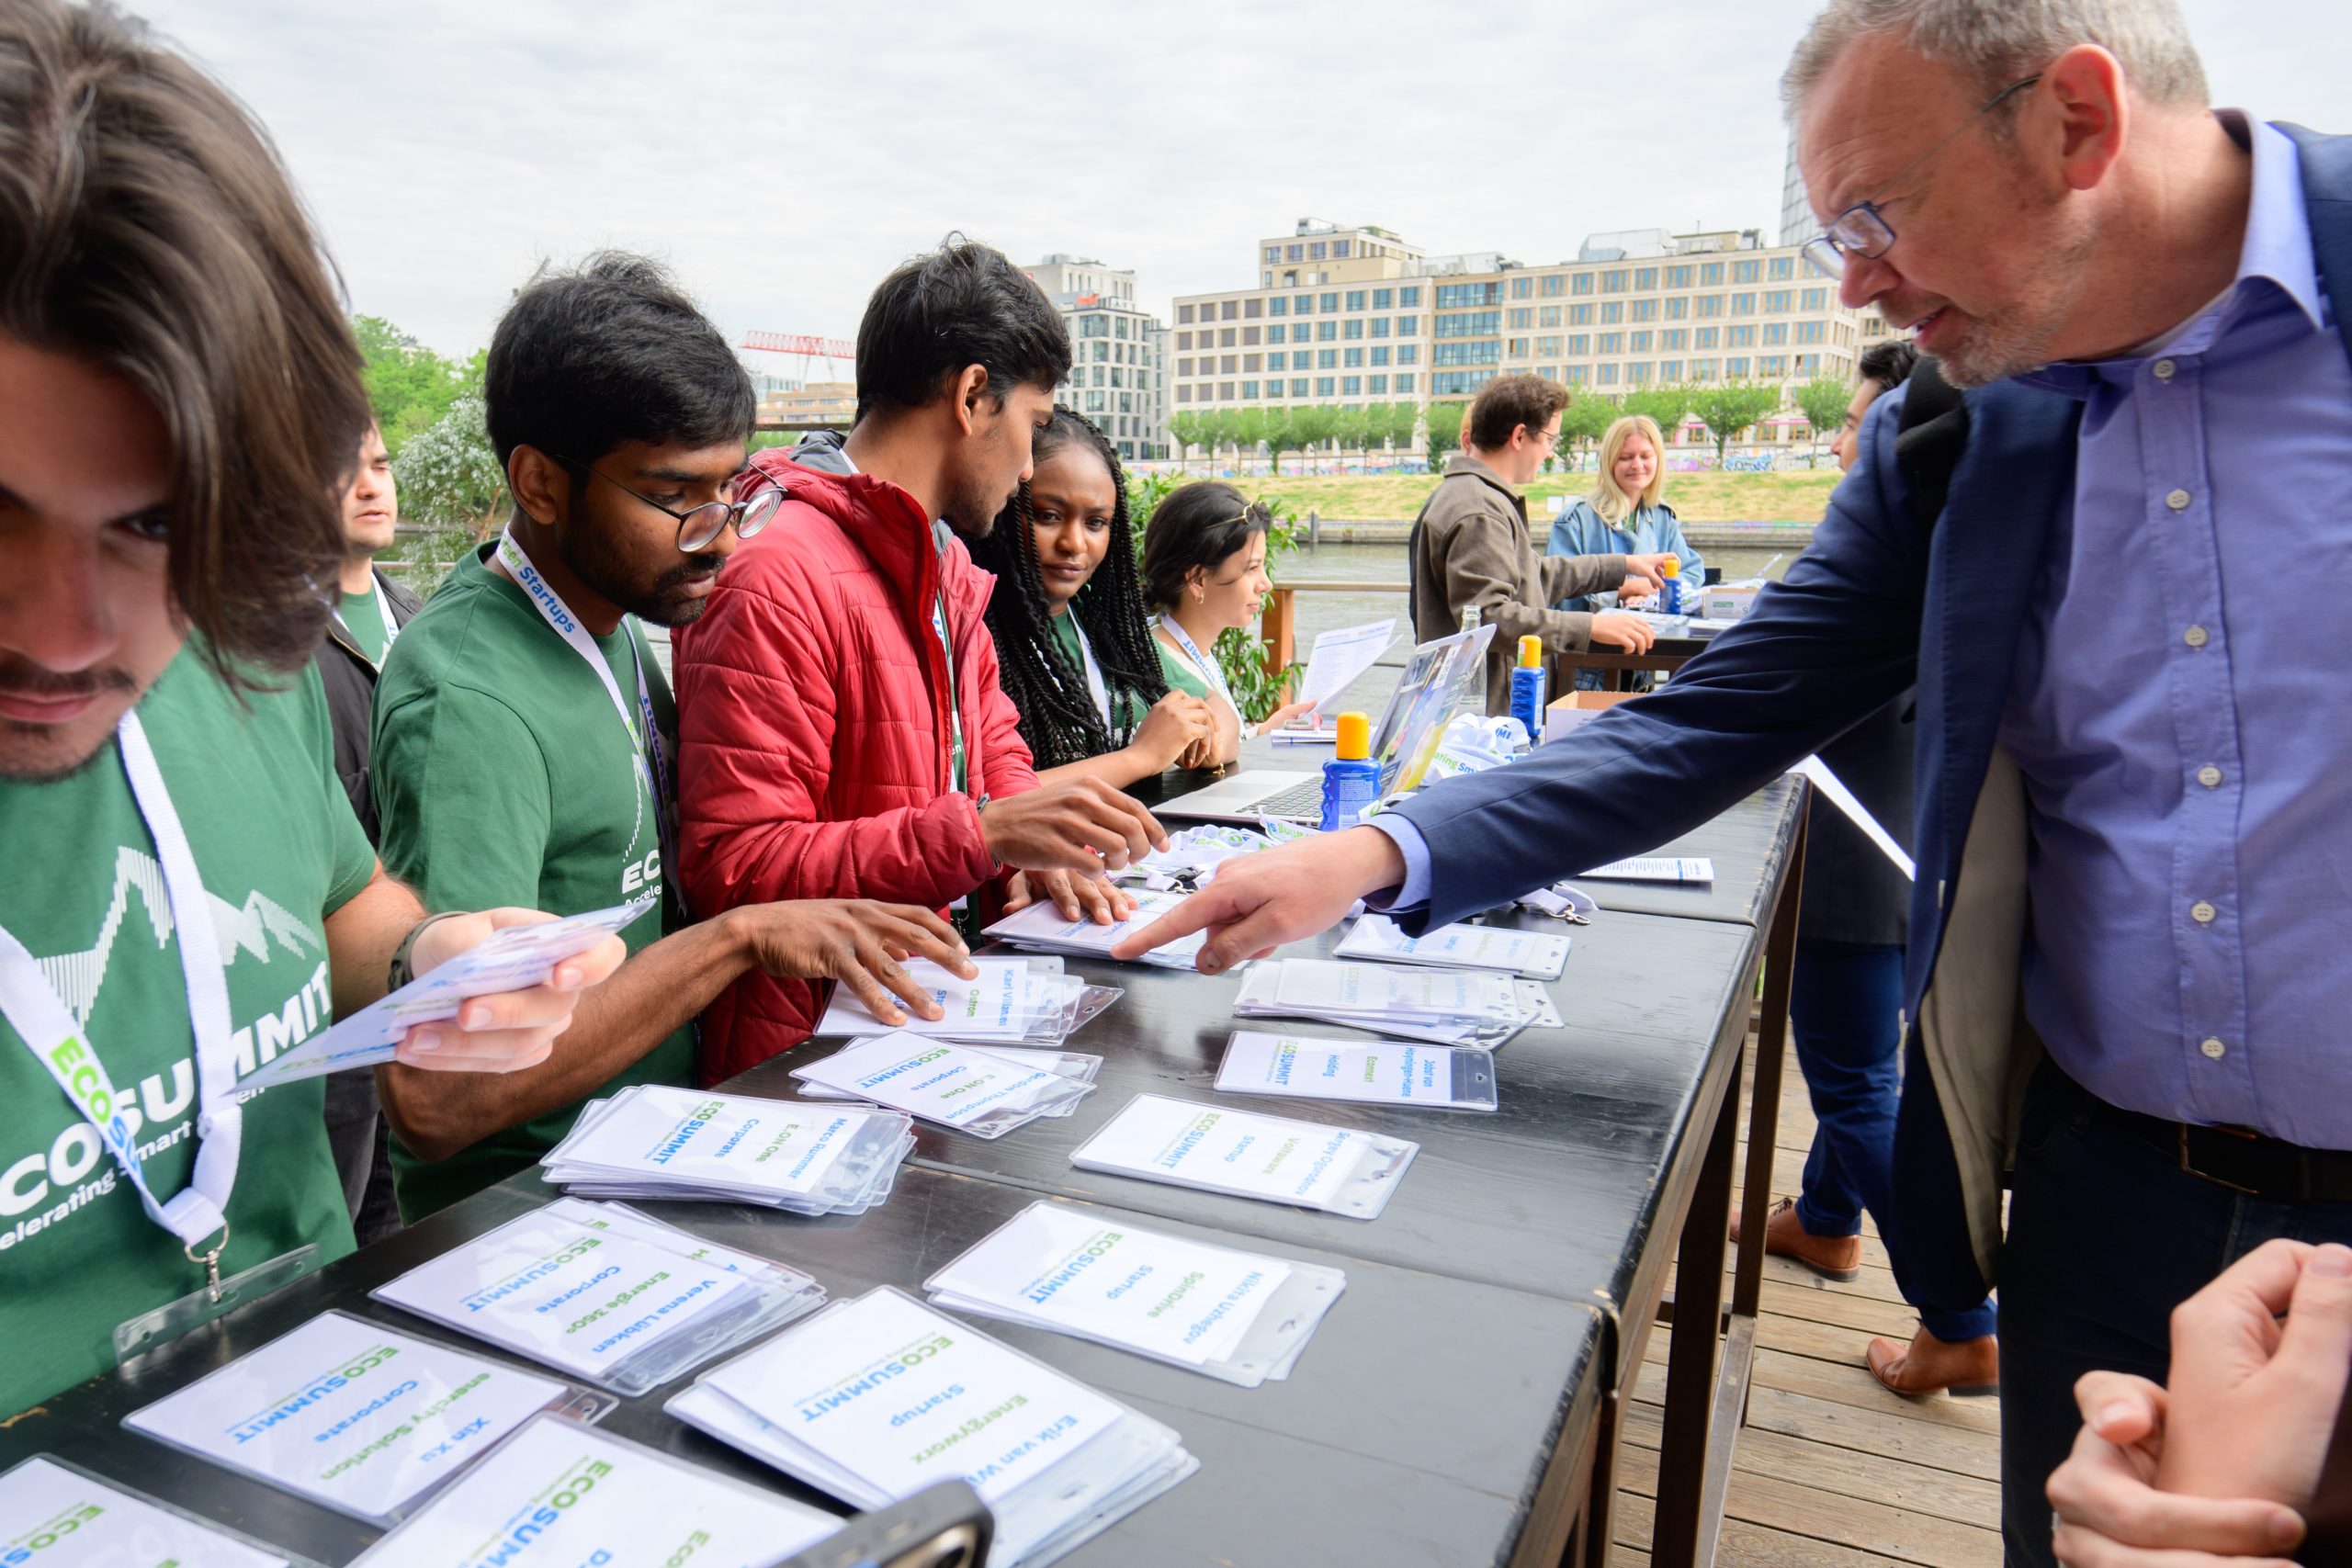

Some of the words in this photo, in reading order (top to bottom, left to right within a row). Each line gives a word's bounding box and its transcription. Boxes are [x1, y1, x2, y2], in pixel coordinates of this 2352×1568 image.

[501, 540, 524, 570] reen
[519, 567, 576, 633] Startups
[967, 989, 978, 1017] Ostrom
[999, 992, 1012, 1026] Villanen
[861, 1048, 950, 1089] ECOSUMMIT
[910, 1066, 967, 1090] Corporate
[1275, 1040, 1298, 1085] ECOSUMMIT
[1323, 1055, 1339, 1077] Holding
[1364, 1056, 1377, 1082] Econnext
[940, 1088, 964, 1099] One
[1005, 1072, 1046, 1091] Gordon
[945, 1092, 1008, 1120] Thompson
[653, 1100, 724, 1164] ECOSUMMIT
[715, 1119, 759, 1157] Corporate
[773, 1124, 799, 1146] E.ON
[820, 1118, 847, 1141] Marco
[1162, 1112, 1221, 1168] ECOSUMMIT
[1326, 1131, 1351, 1156] Sergey
[119, 1121, 192, 1178] mart
[756, 1146, 779, 1162] One
[788, 1144, 826, 1179] Rummer
[1224, 1135, 1255, 1162] Startup
[1262, 1138, 1300, 1175] Voltaware
[1295, 1156, 1333, 1196] Ogorodnov
[468, 1238, 602, 1314] ECOSUMMIT
[1029, 1233, 1123, 1304] ECOSUMMIT
[1106, 1265, 1153, 1299] Startup
[536, 1266, 620, 1313] Corporate
[606, 1272, 670, 1308] Energie
[657, 1280, 717, 1314] Verena
[1147, 1272, 1204, 1318] SpinDrive
[1227, 1271, 1263, 1306] Nikita
[593, 1315, 660, 1352] Lübken
[1183, 1303, 1233, 1344] Uzhegov
[235, 1348, 399, 1443] ECOSUMMIT
[801, 1337, 954, 1422] ECOSUMMIT
[314, 1381, 418, 1442] Corporate
[890, 1384, 965, 1427] Startup
[452, 1417, 489, 1440] Xin
[912, 1394, 1028, 1464] Energyworx
[1036, 1416, 1078, 1441] Erik
[322, 1425, 413, 1479] Solution
[421, 1442, 453, 1461] Xu
[1000, 1441, 1037, 1464] van
[471, 1460, 613, 1568] ECOSUMM
